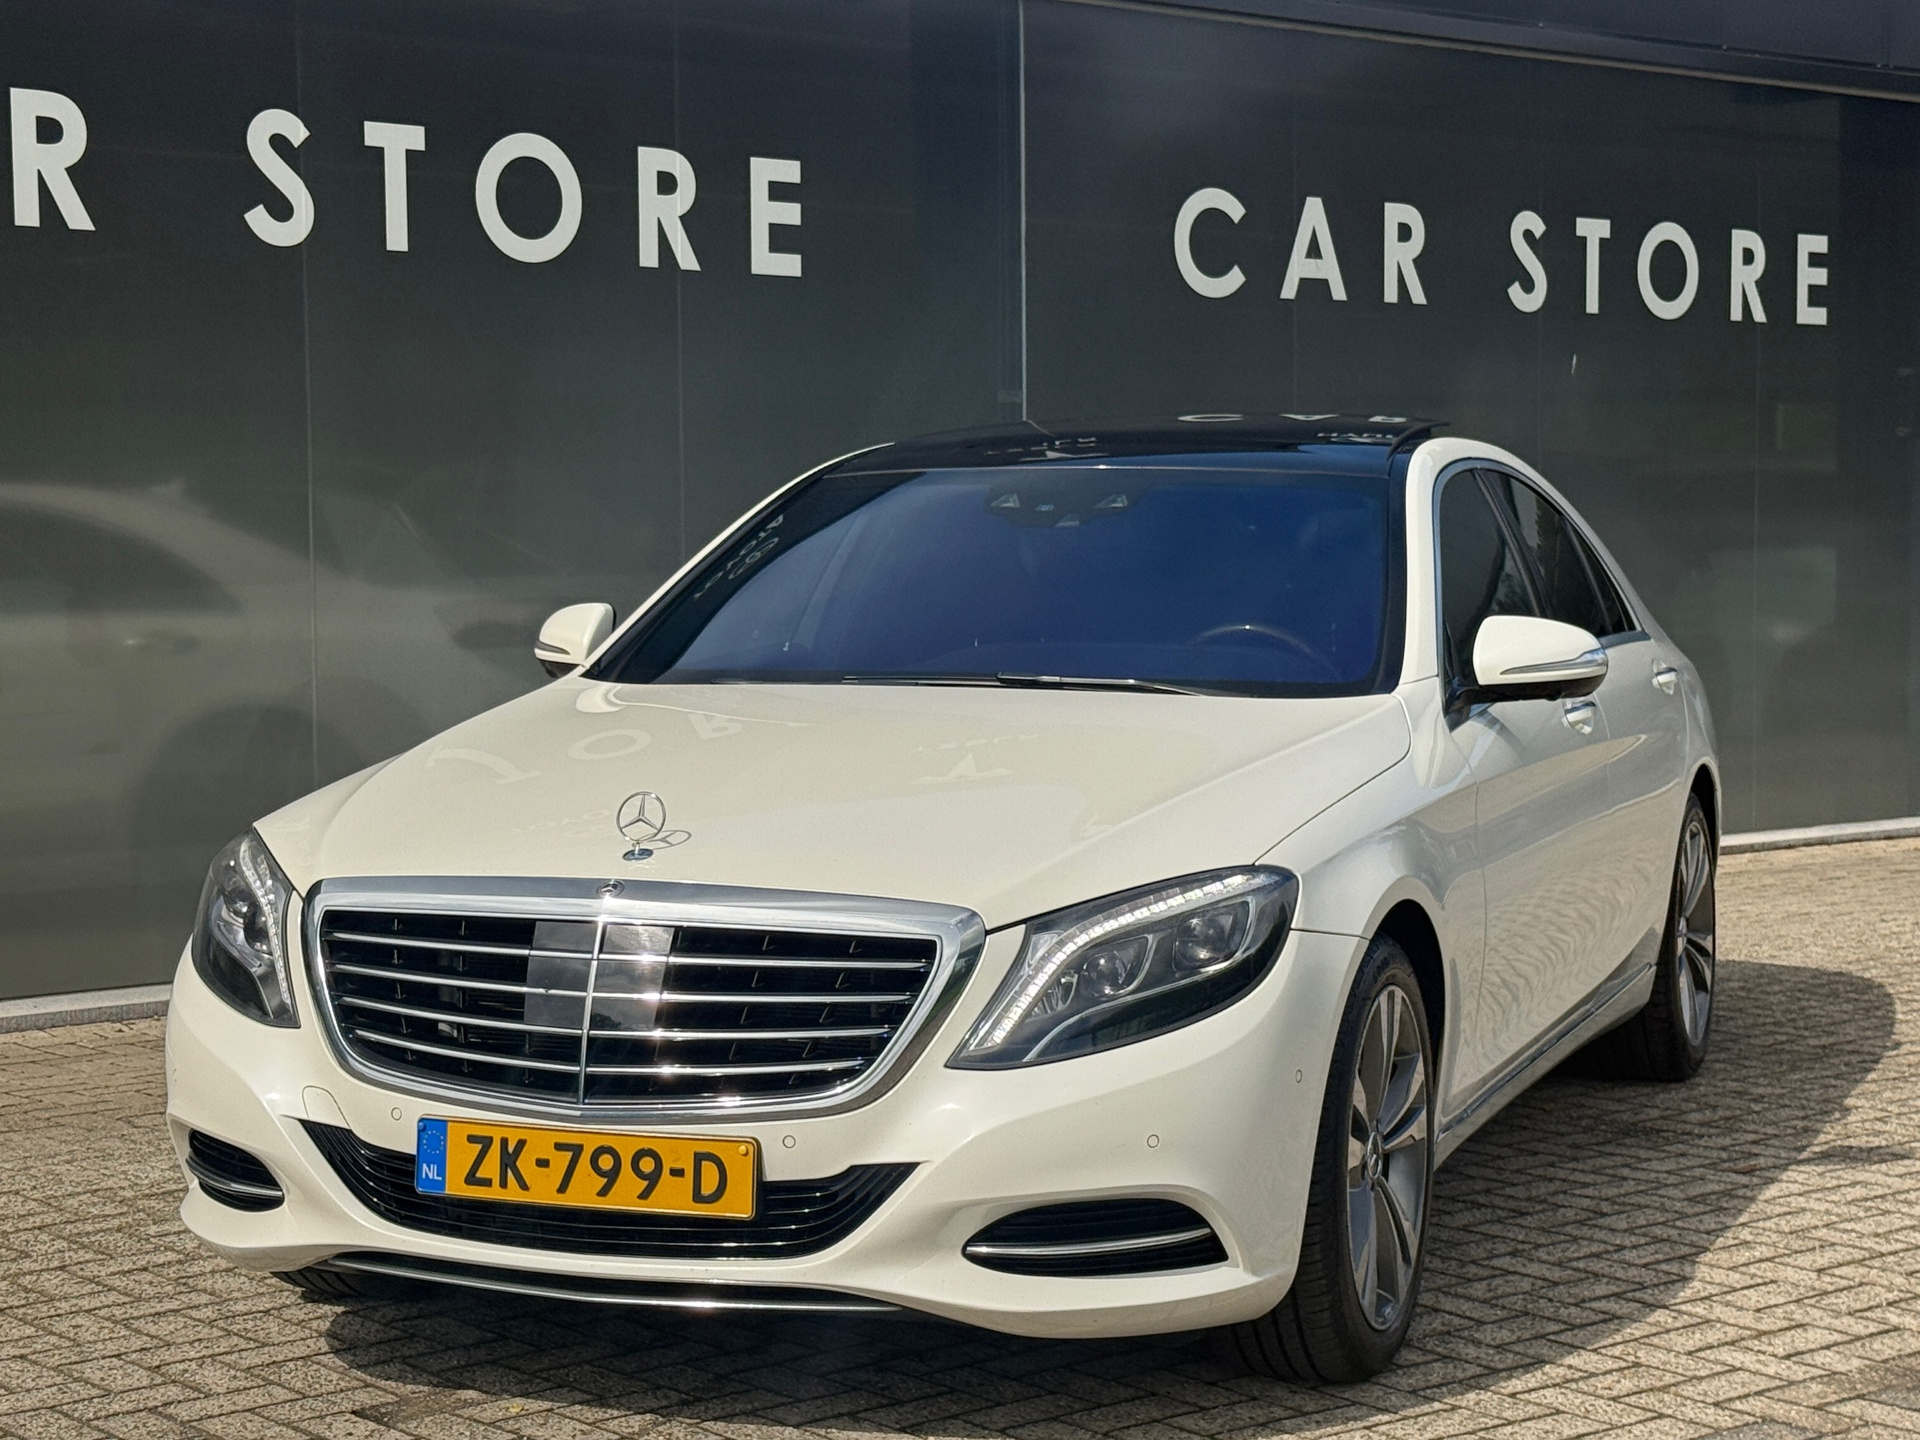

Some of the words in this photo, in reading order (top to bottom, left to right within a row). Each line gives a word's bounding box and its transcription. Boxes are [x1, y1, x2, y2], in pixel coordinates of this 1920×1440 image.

[9, 87, 96, 231] R
[243, 108, 803, 278] STORE
[1174, 187, 1428, 305] CAR
[1507, 210, 1830, 326] STORE
[421, 1162, 443, 1181] NL
[463, 1133, 729, 1205] ZK-799-D
